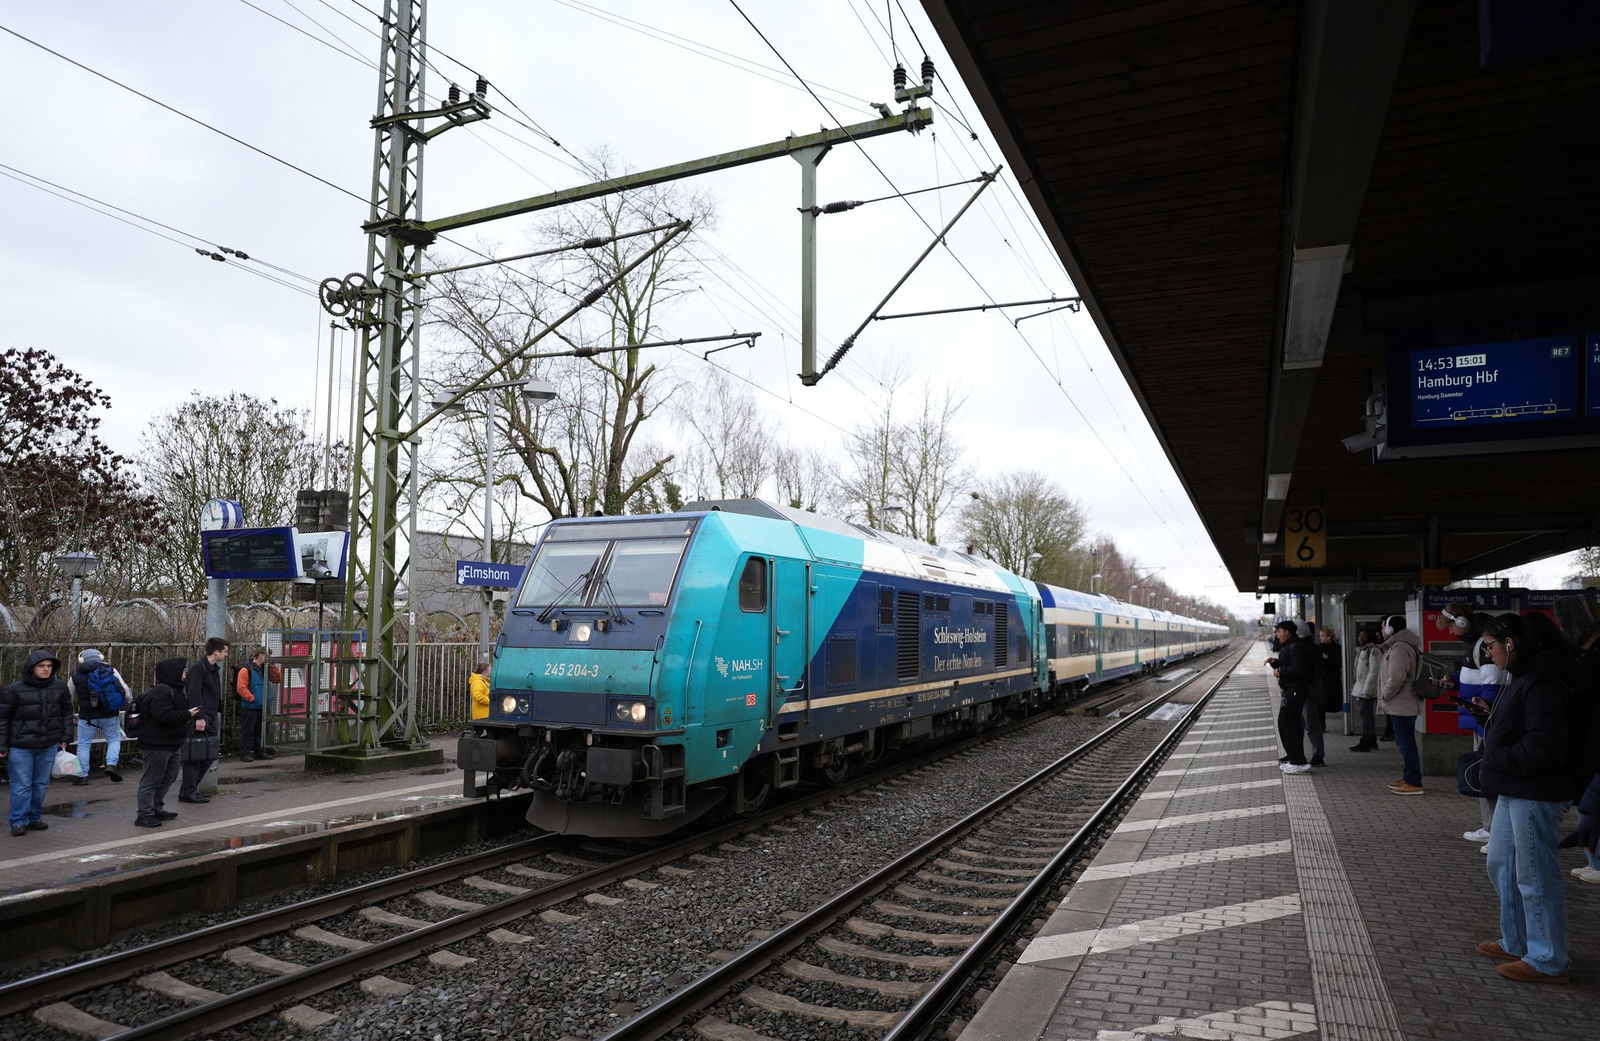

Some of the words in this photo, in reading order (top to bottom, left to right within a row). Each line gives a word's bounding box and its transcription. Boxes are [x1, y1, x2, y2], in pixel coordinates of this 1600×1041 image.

[1553, 348, 1563, 356] RE
[1564, 347, 1569, 355] 7
[1417, 357, 1454, 372] 14:53
[1459, 356, 1484, 366] 15:01
[1418, 374, 1472, 388] Hamburg
[1476, 369, 1499, 383] Hbf
[1440, 391, 1463, 399] Dammtor
[1287, 508, 1324, 533] 30
[1296, 535, 1315, 562] 6
[463, 565, 510, 581] Elmshorn
[1429, 594, 1468, 602] Fahrkarten
[934, 626, 987, 649] Schleswig-Holstein
[731, 658, 764, 672] NAH.SH
[934, 655, 946, 672] Der
[946, 653, 962, 671] echte
[544, 663, 566, 676] 245
[566, 663, 599, 677] 204-3
[746, 694, 757, 706] DB
[759, 718, 765, 731] 2
